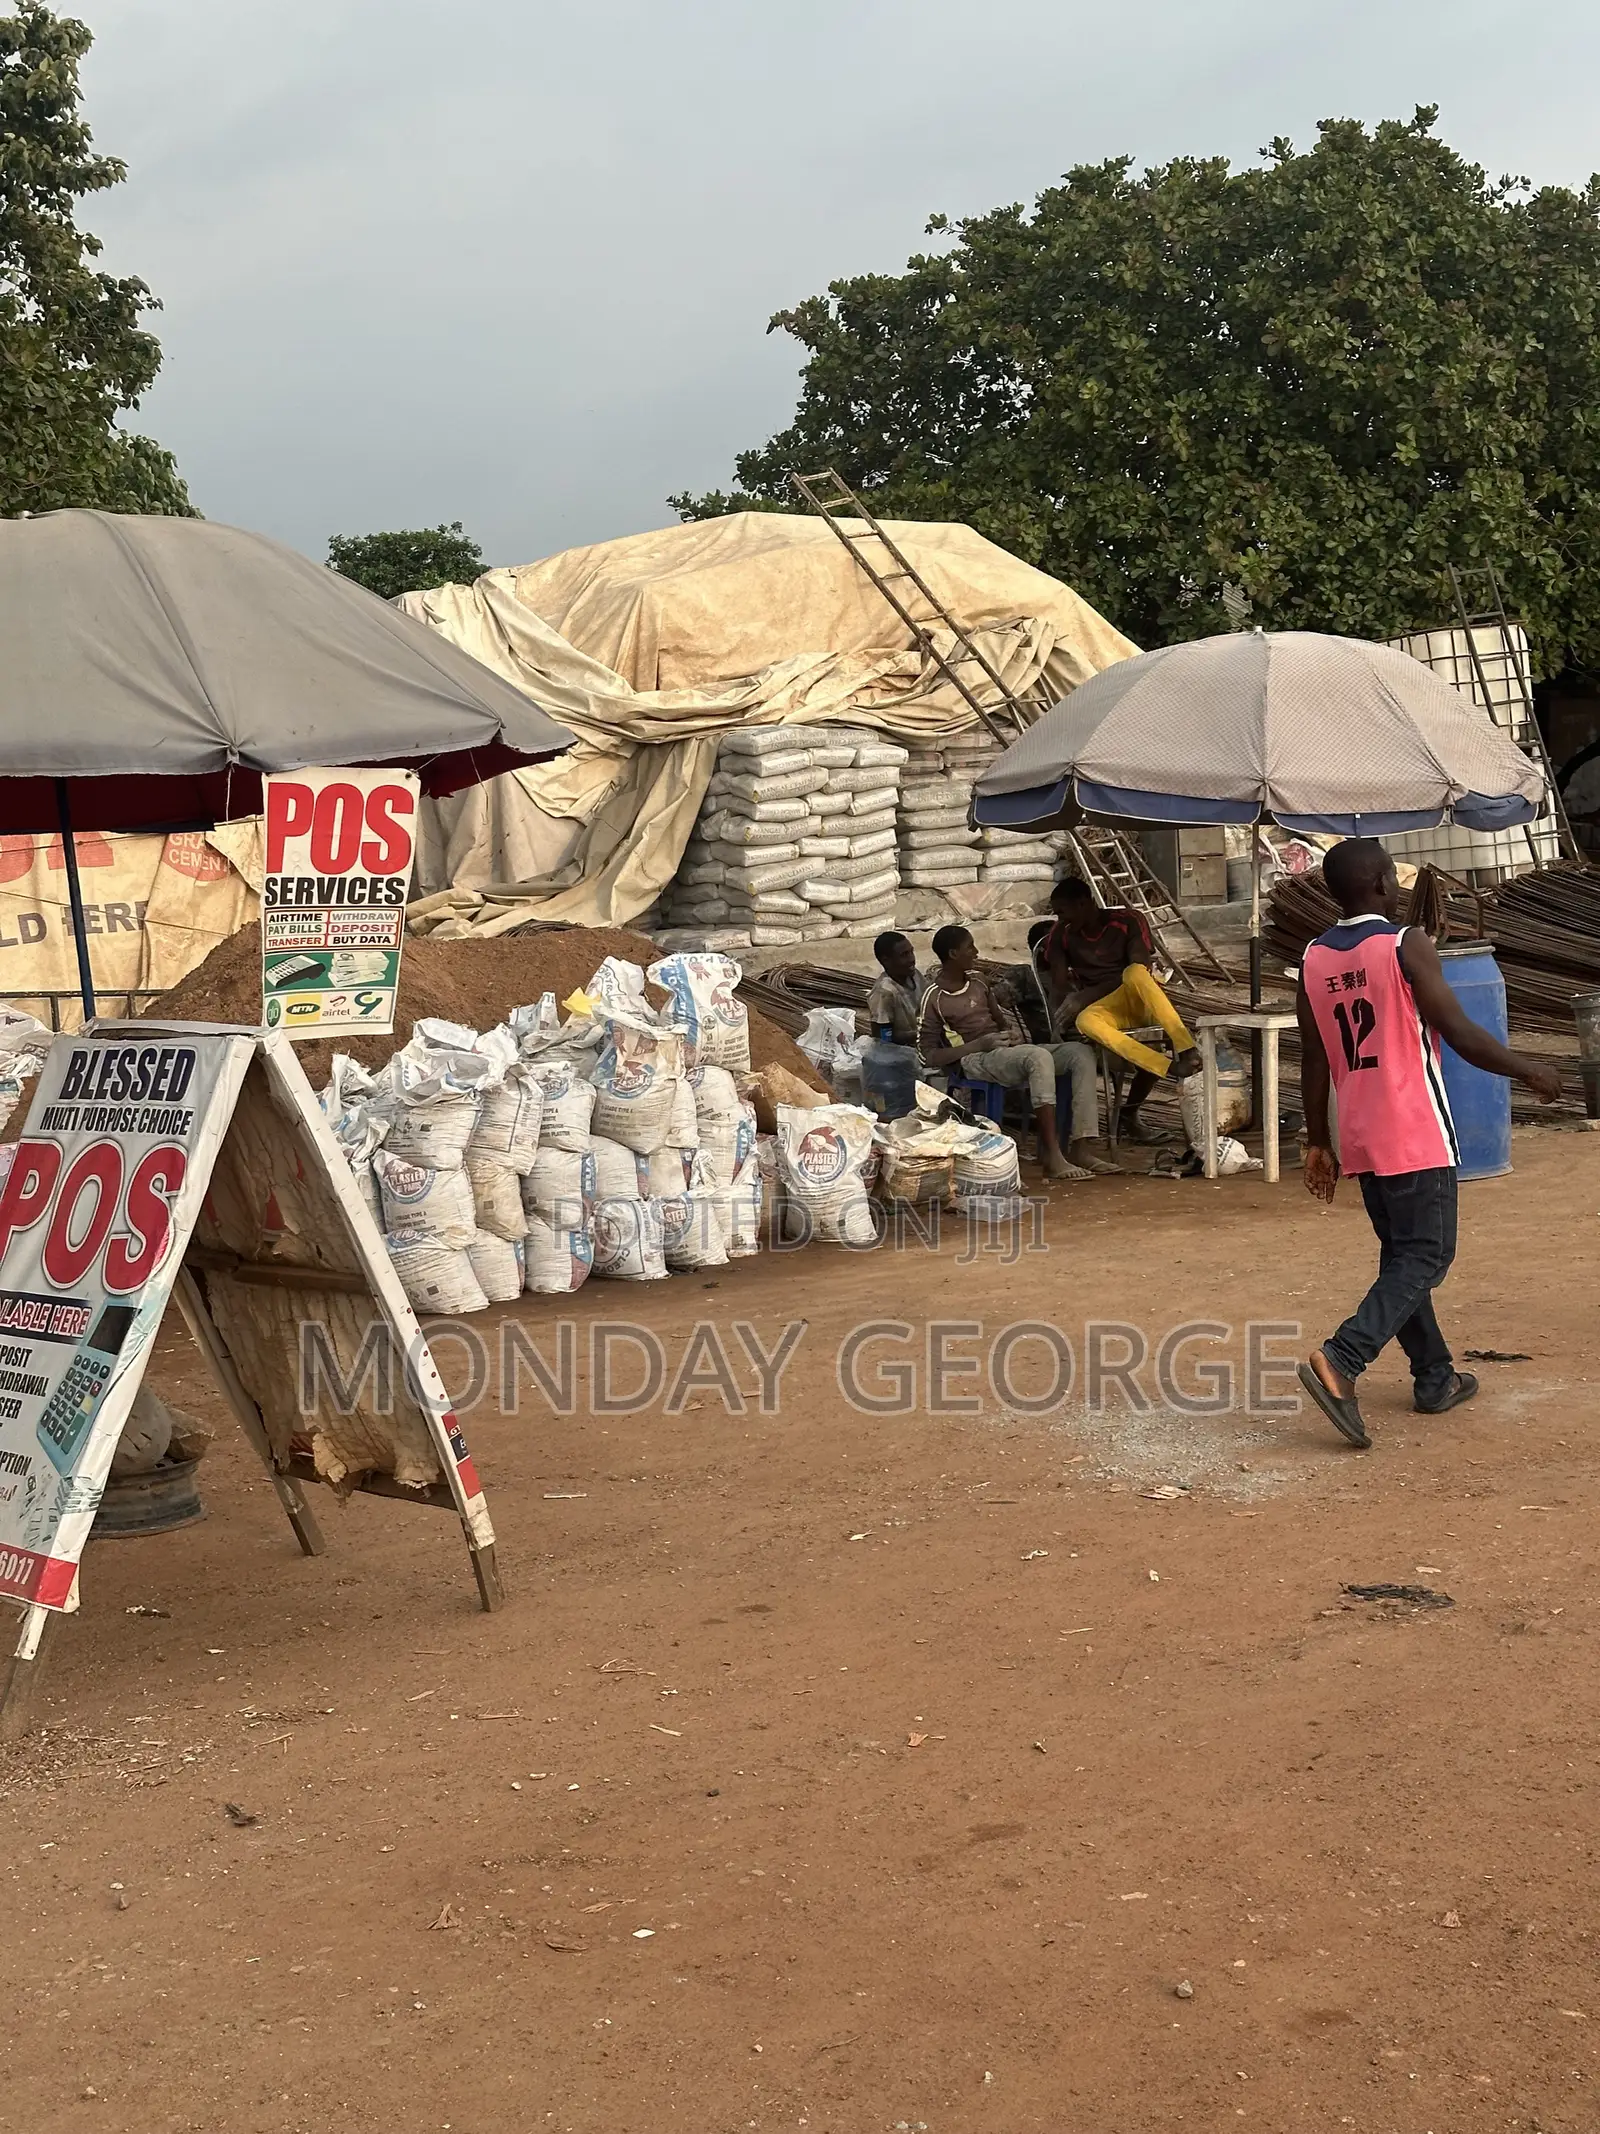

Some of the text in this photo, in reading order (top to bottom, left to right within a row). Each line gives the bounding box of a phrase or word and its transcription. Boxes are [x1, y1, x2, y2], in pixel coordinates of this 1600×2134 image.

[266, 781, 414, 876] POS
[169, 849, 227, 873] CEMEN
[265, 877, 406, 906] SERVICES
[268, 913, 323, 923] AIRTIME
[330, 924, 394, 933] DEPOSIT
[332, 912, 397, 921] WITHDRAW
[268, 924, 323, 936] PAY BILLS
[268, 937, 322, 947] TRANSFER
[333, 935, 391, 944] BUY DATA
[291, 1005, 315, 1014] MTN
[322, 1008, 351, 1017] airtel
[1333, 997, 1379, 1072] 12
[58, 1047, 196, 1102] BLESSED
[40, 1106, 194, 1136] MULTI PURPOSE CHOICE
[804, 1152, 838, 1165] PLASTER
[0, 1140, 188, 1294] POS
[48, 1304, 92, 1338] HERE
[0, 1344, 32, 1368] POSIT
[0, 1370, 49, 1397] HDRAWAL
[0, 1451, 32, 1476] PTION
